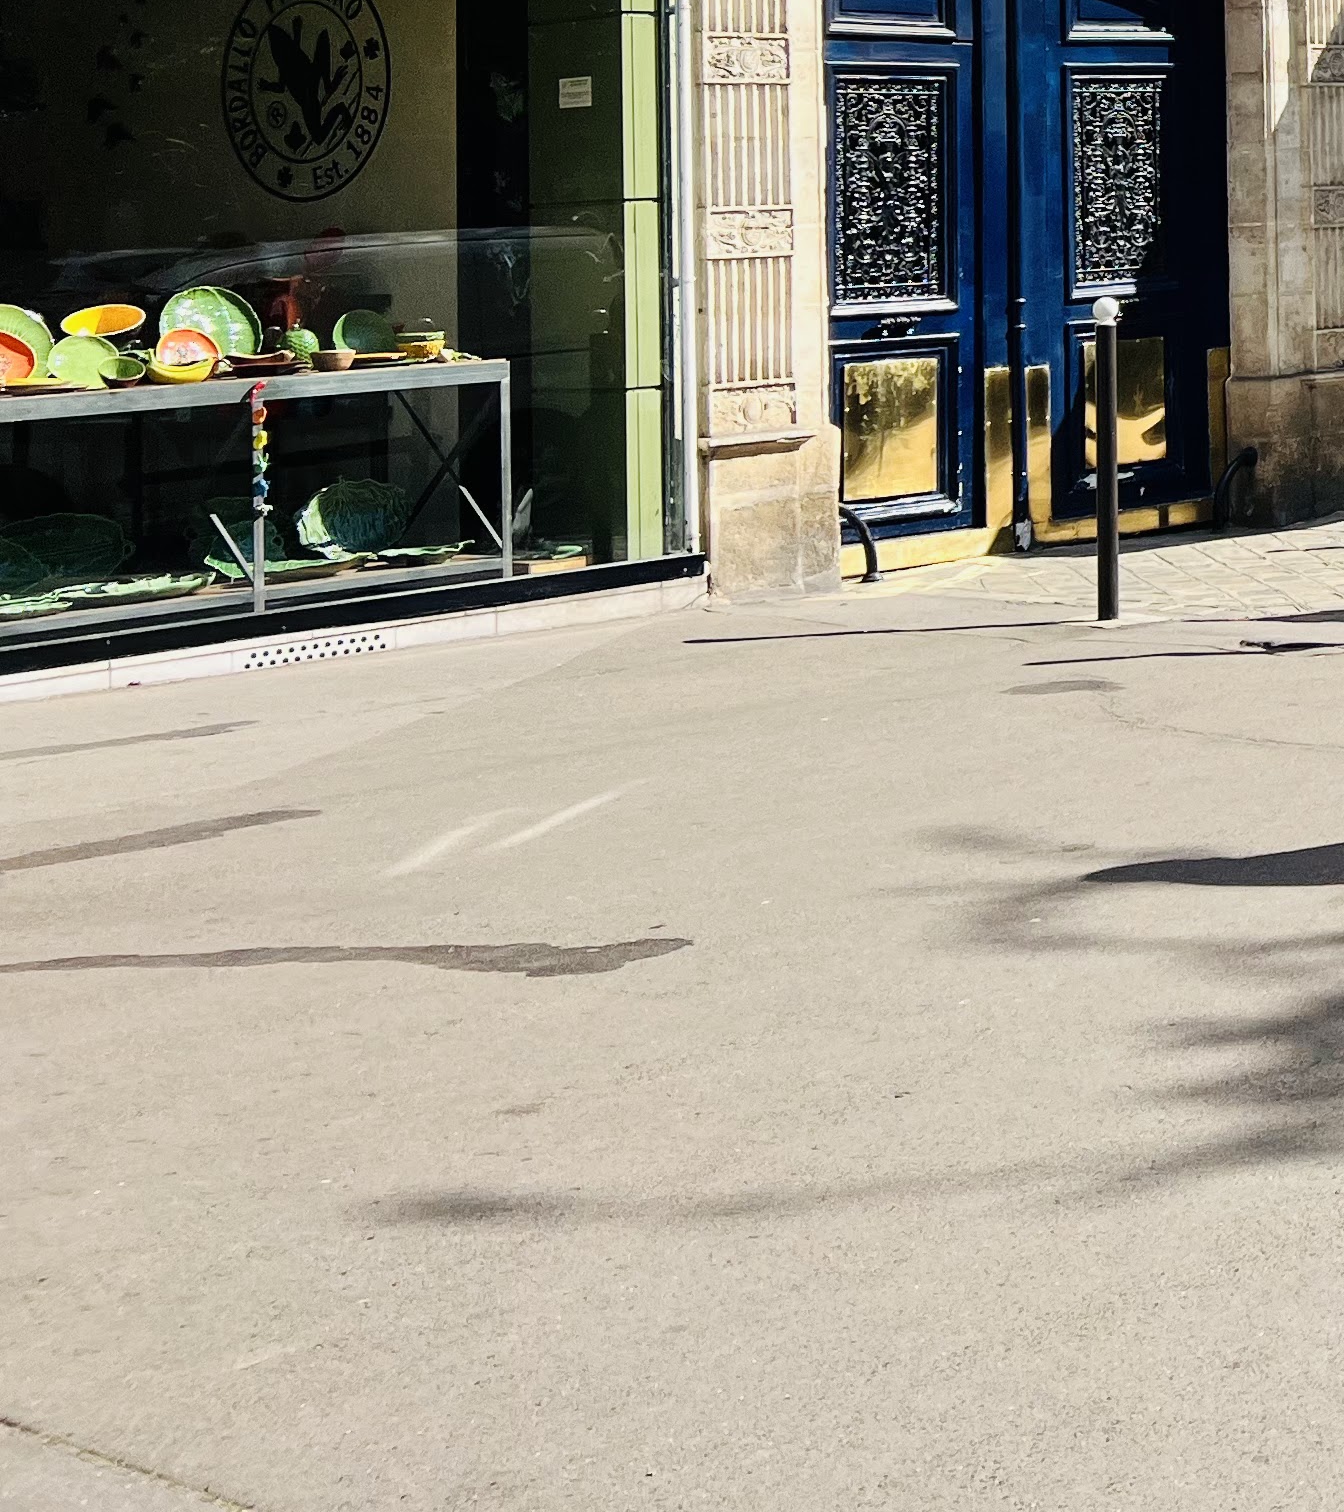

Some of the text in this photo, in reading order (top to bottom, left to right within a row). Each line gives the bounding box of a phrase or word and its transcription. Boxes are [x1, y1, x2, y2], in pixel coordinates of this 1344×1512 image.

[228, 17, 269, 170] BORDALLO
[311, 85, 383, 191] Est. 1884
